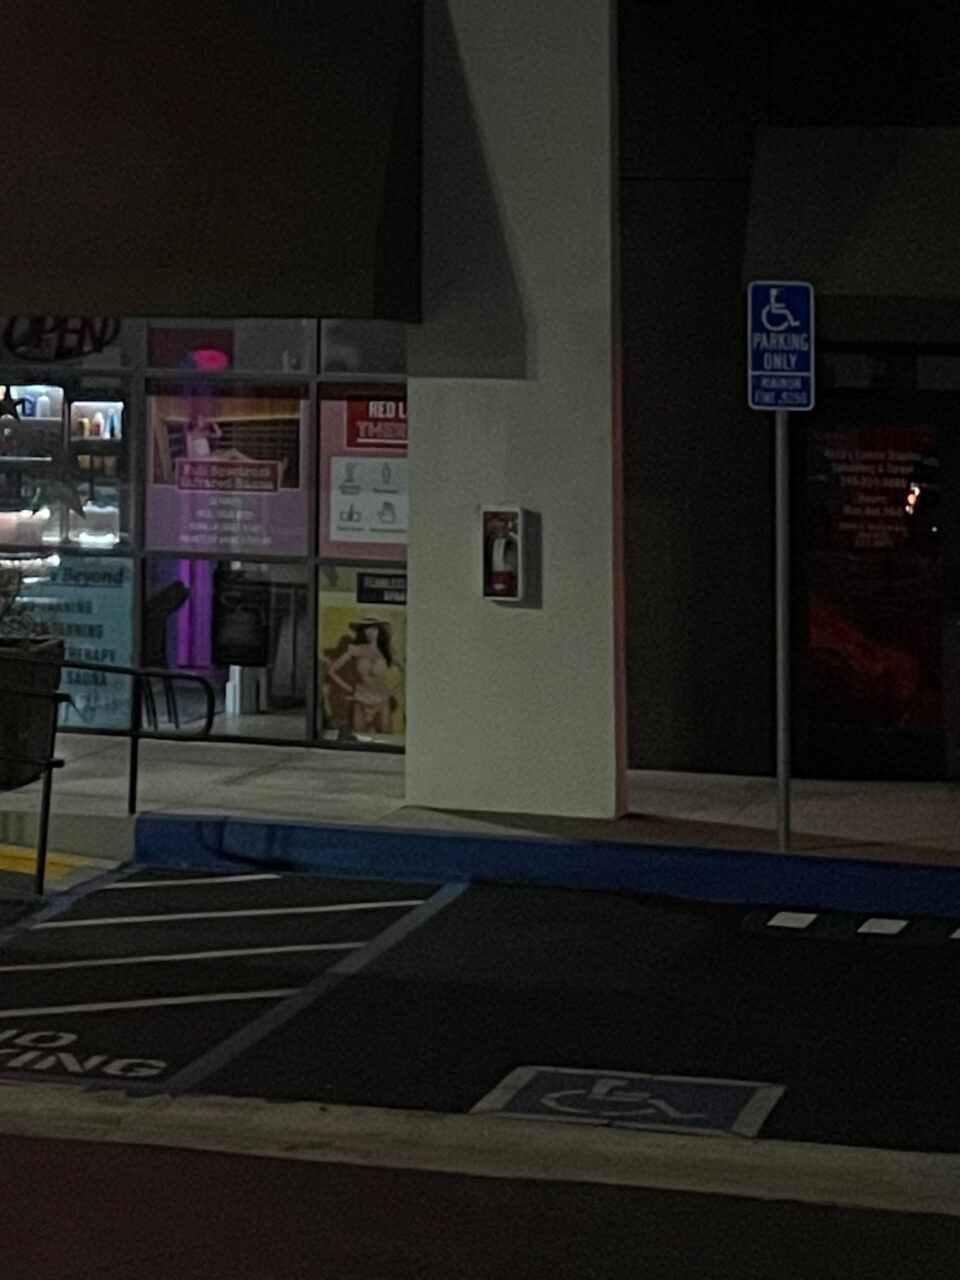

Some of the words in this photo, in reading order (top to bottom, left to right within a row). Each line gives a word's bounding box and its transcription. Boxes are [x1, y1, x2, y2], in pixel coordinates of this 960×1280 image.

[752, 331, 809, 351] PARKING
[763, 353, 798, 370] ONLY
[368, 400, 396, 418] RED
[62, 567, 124, 586] Beyond
[66, 670, 108, 686] SAUNA
